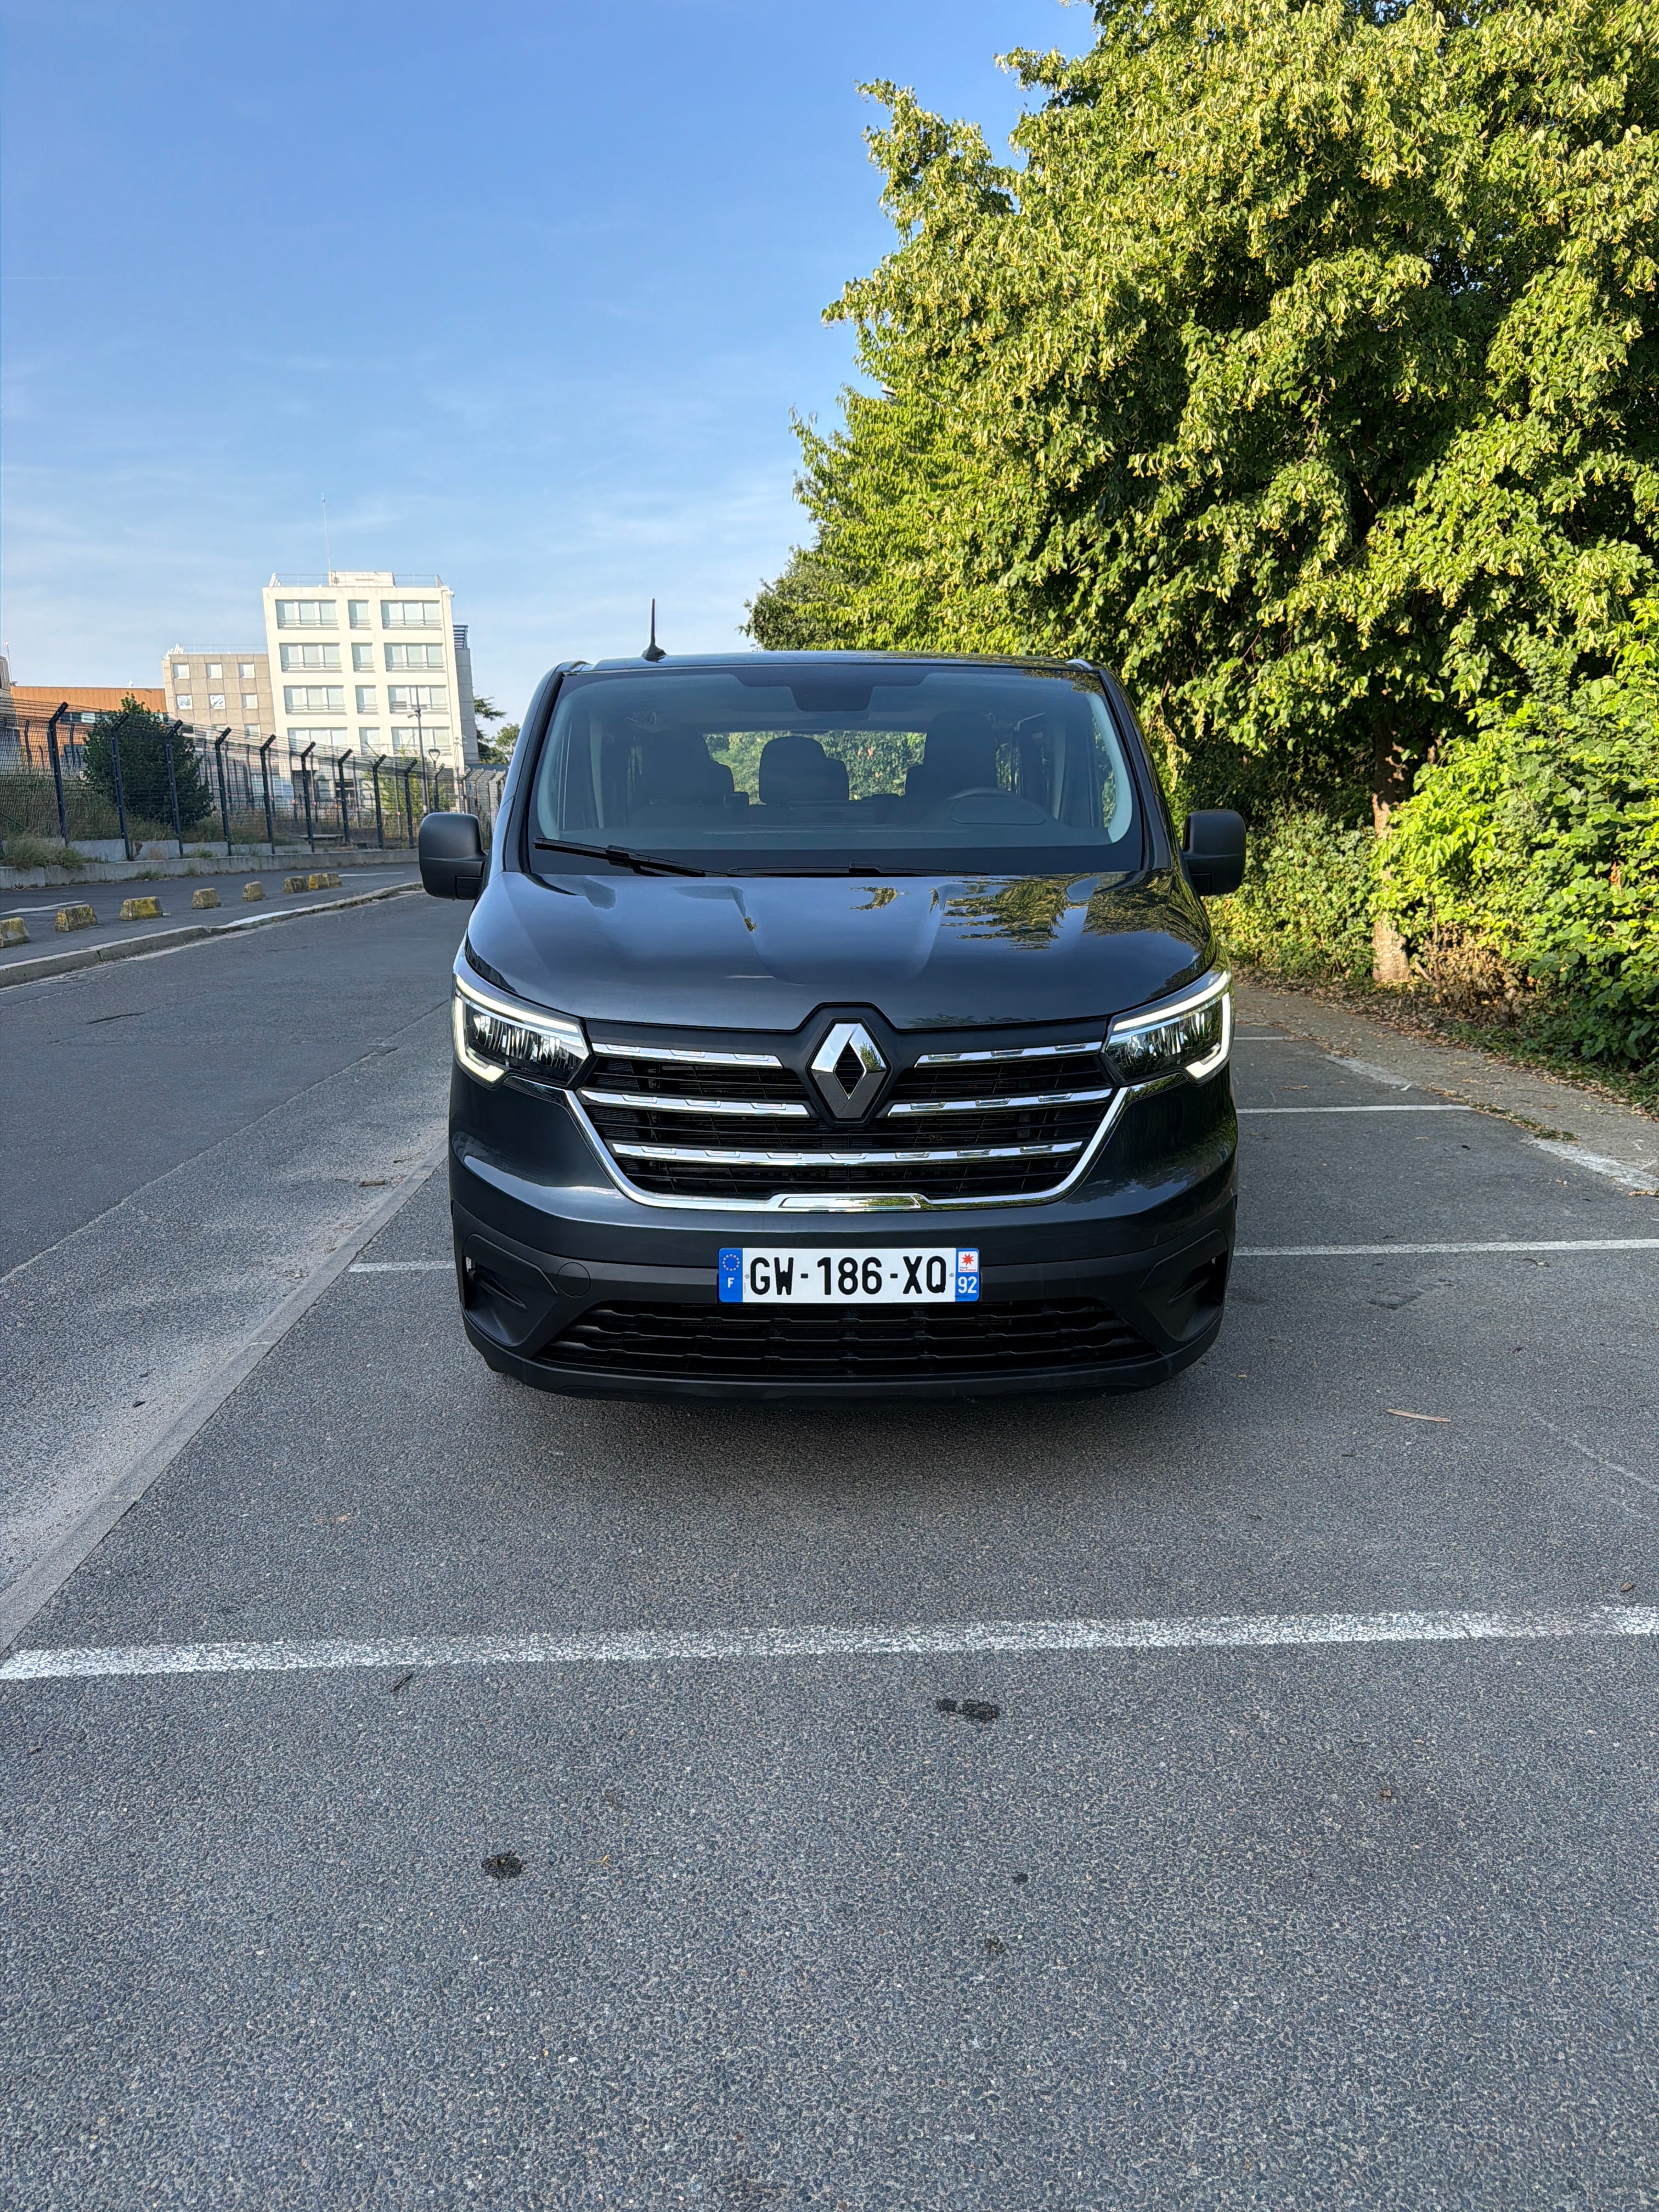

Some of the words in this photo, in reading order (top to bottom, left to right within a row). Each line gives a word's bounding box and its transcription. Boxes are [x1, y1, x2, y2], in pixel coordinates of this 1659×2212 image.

[727, 1277, 735, 1288] F
[750, 1255, 946, 1295] GW-186-XQ
[958, 1276, 977, 1294] 92
